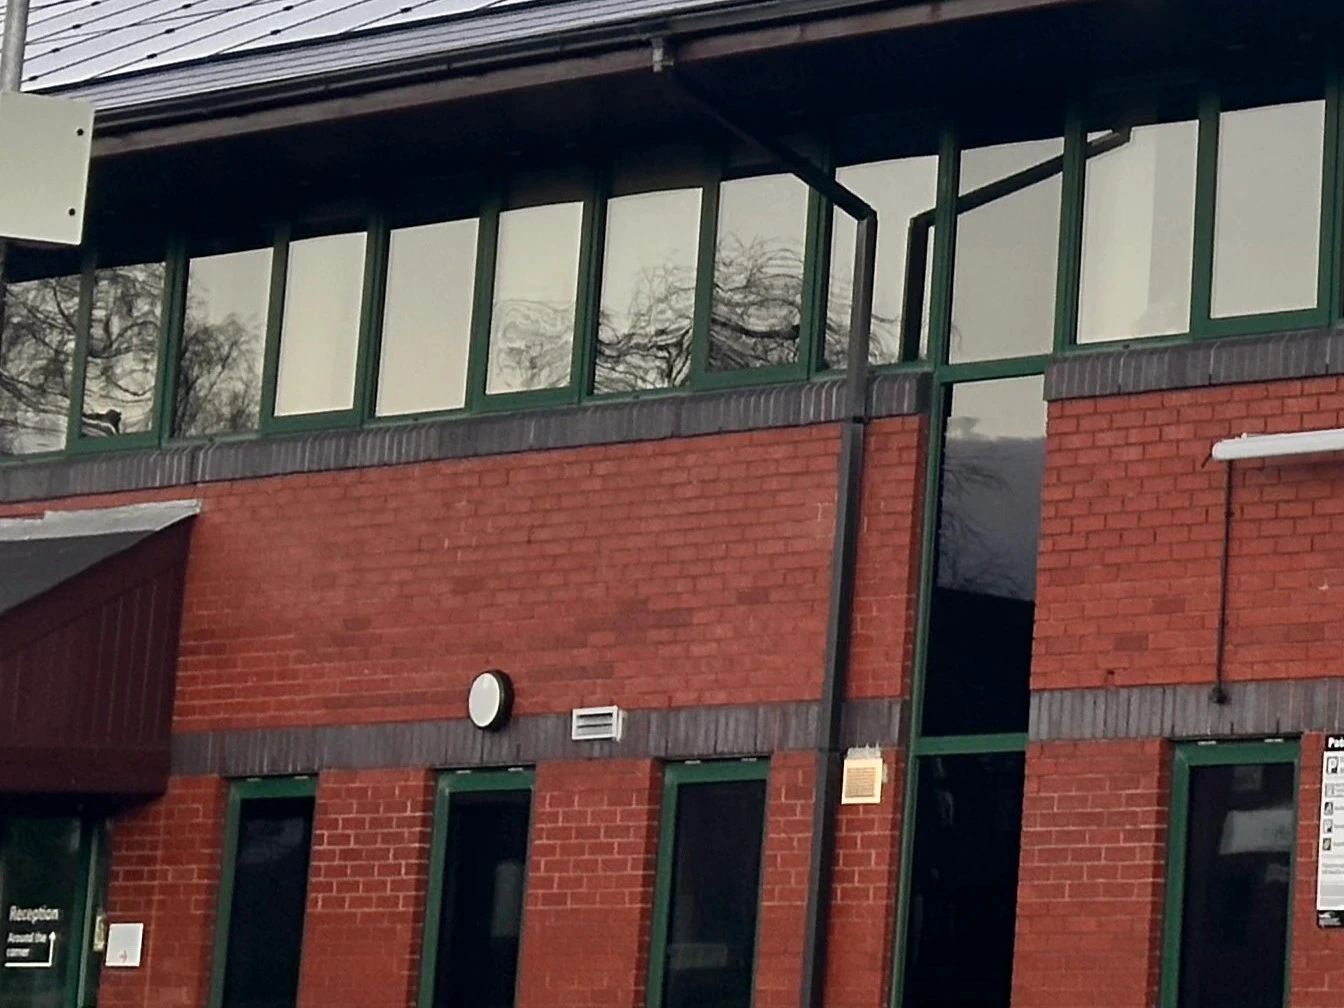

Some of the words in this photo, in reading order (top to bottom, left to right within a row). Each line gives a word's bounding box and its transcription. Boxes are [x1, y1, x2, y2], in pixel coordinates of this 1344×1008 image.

[9, 904, 59, 925] Reception
[7, 932, 34, 943] Around
[34, 932, 47, 943] the
[5, 947, 30, 958] corner
